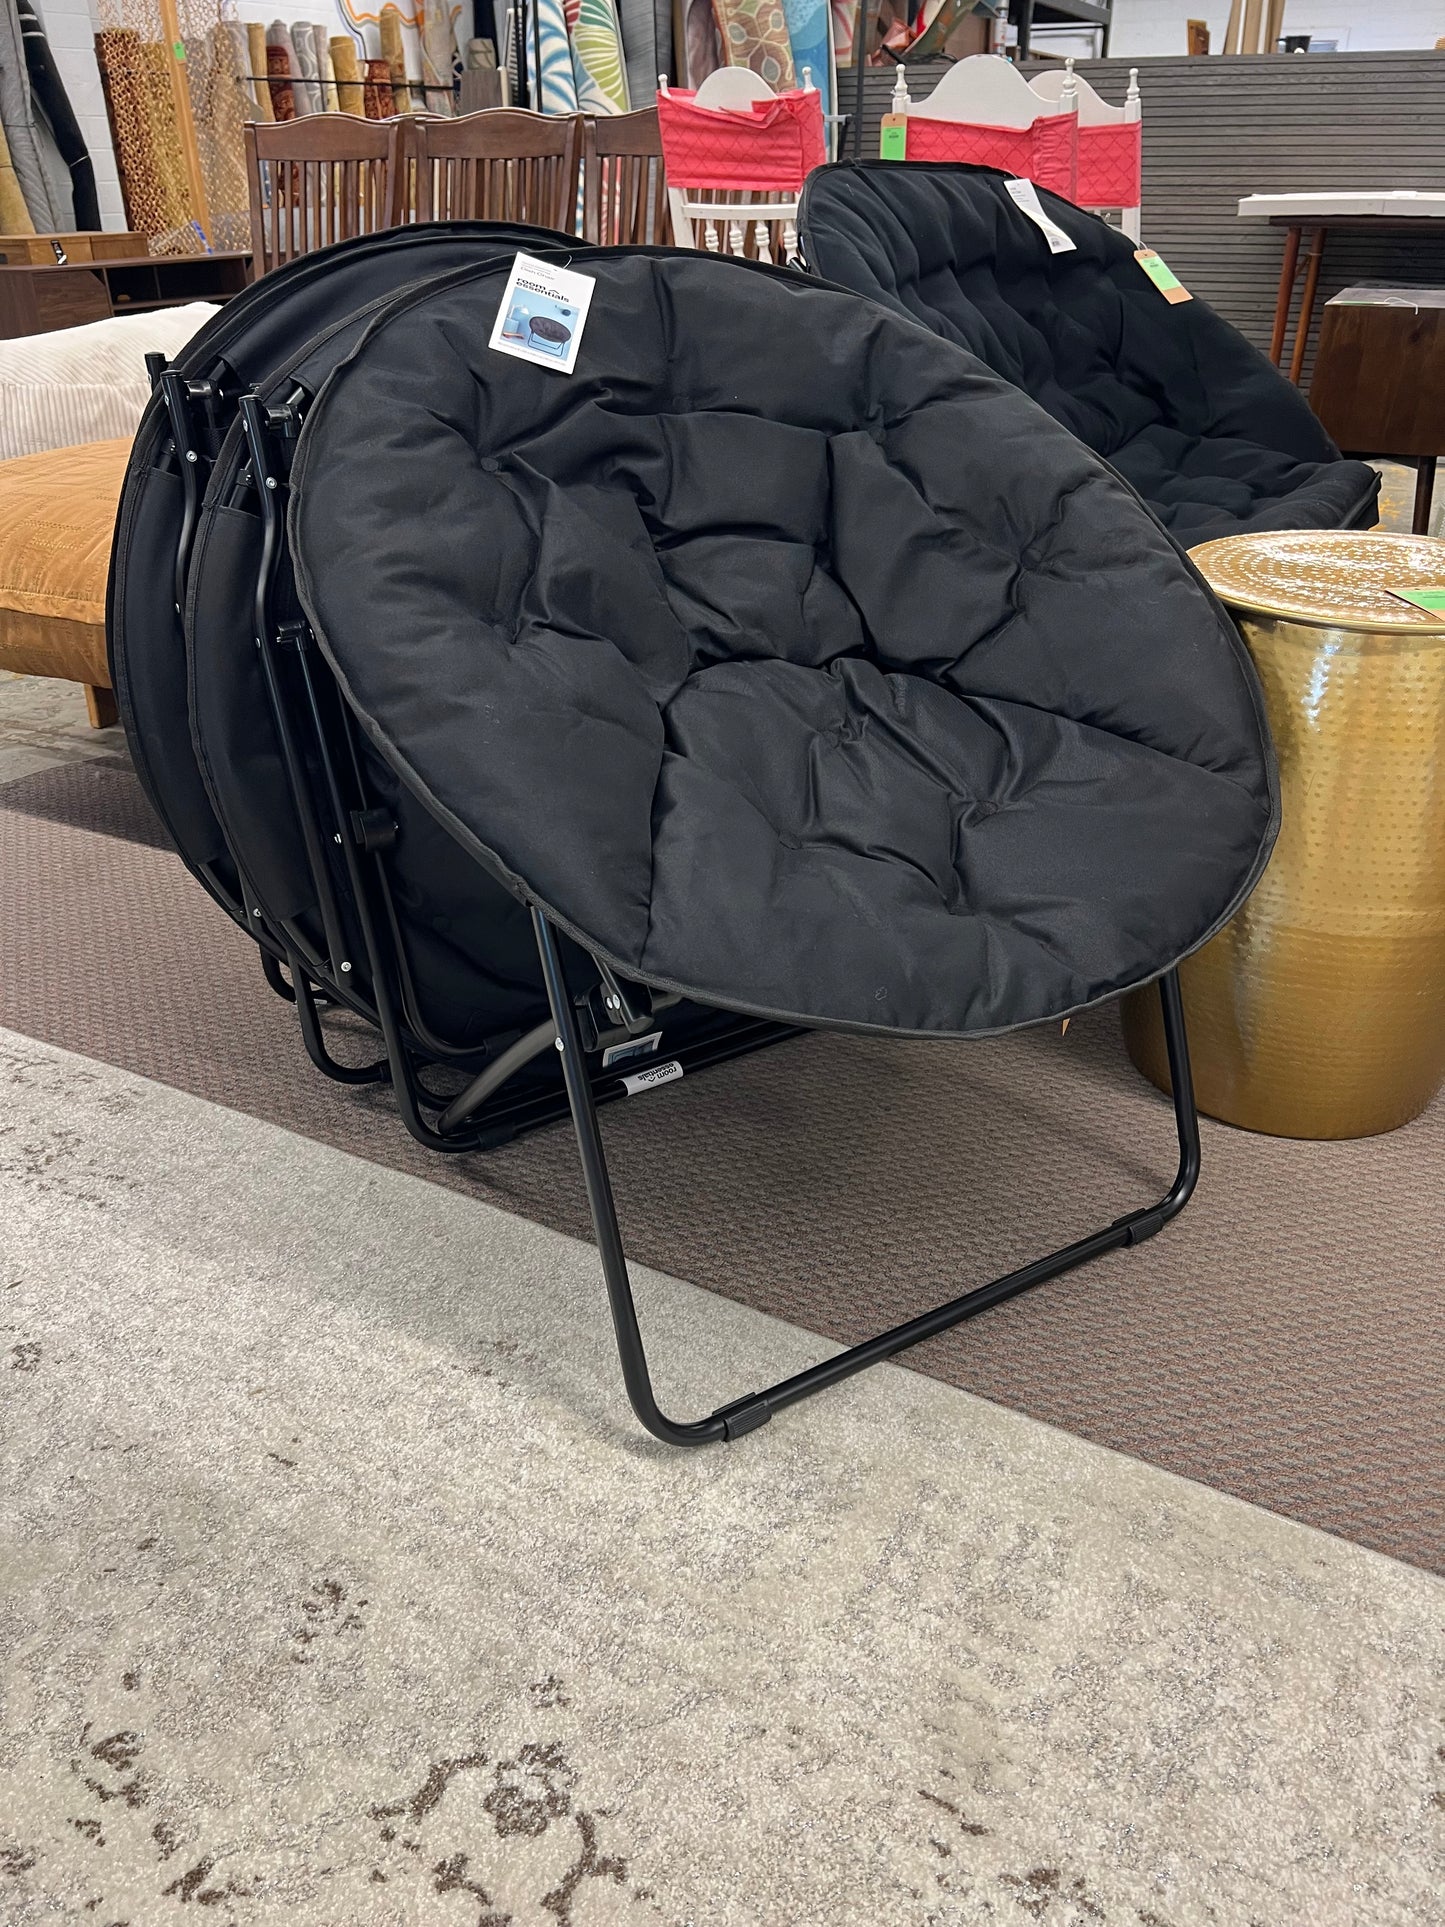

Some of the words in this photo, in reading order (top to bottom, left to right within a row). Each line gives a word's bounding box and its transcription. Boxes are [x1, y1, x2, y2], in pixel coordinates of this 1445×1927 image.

[516, 281, 569, 302] essentials
[517, 278, 546, 290] room
[637, 1063, 674, 1081] essentials
[657, 1067, 677, 1079] room
